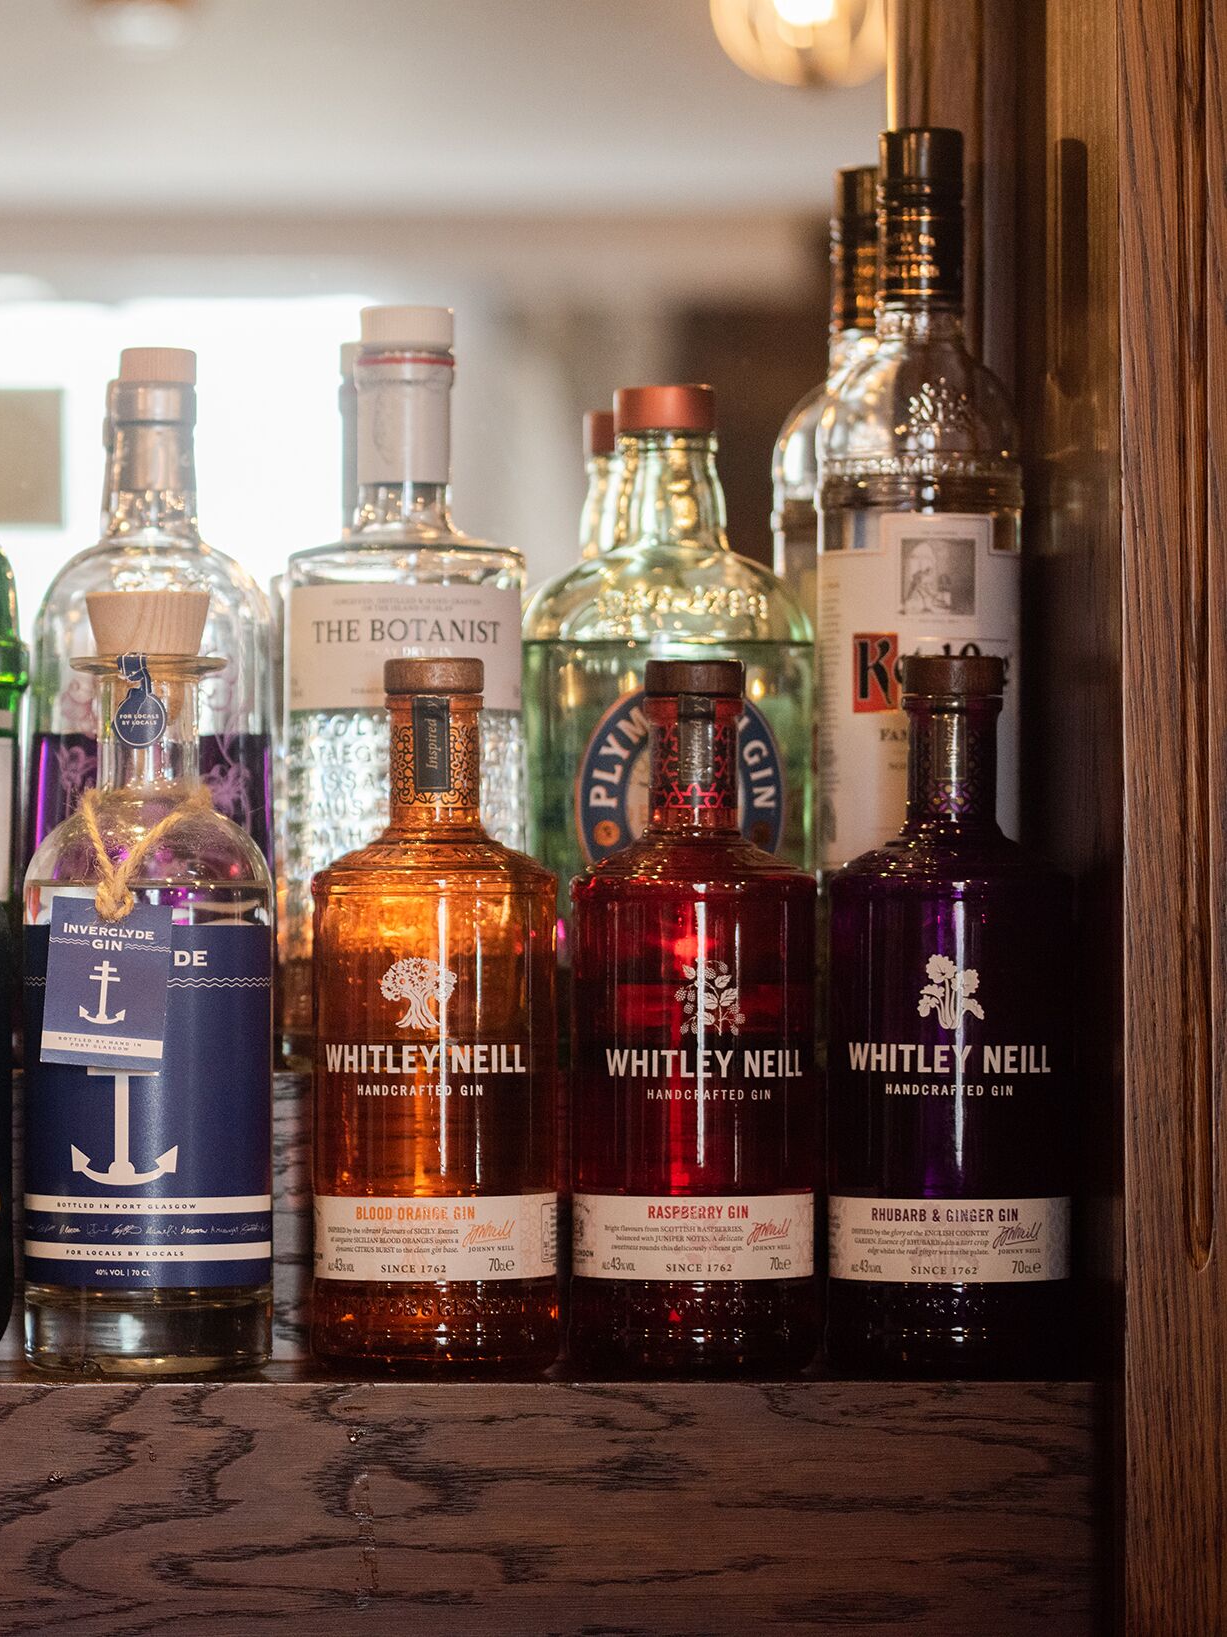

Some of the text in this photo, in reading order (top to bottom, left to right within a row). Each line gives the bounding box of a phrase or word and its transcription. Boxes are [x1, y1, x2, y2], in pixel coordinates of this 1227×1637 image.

[310, 618, 500, 644] THE BOTANIST
[424, 717, 442, 769] Inspired
[742, 739, 775, 809] GIN
[63, 922, 154, 941] INVERCLYDE
[92, 939, 123, 951] GIN
[326, 1044, 526, 1074] WHITLEY NEILL
[606, 1049, 802, 1078] WHITLEY NEILL
[848, 1042, 1051, 1074] WHITLEY NEILL
[357, 1084, 484, 1097] HANDCRAFTED GIN
[647, 1089, 771, 1100] HANDCRAFTED GIN
[885, 1083, 1014, 1096] HANDCRAFTED GIN
[356, 1206, 475, 1220] BLOOD ORANGE GIN
[648, 1205, 749, 1219] RASPBERRY GIN
[871, 1208, 1019, 1222] RHUBARB & GINGER GIN
[109, 1269, 125, 1277] VOL
[132, 1269, 142, 1277] 70
[143, 1269, 151, 1277] CL
[381, 1264, 446, 1273] SINCE 1762
[666, 1263, 733, 1272] SINCE 1762
[910, 1266, 978, 1274] SINCE 1762
